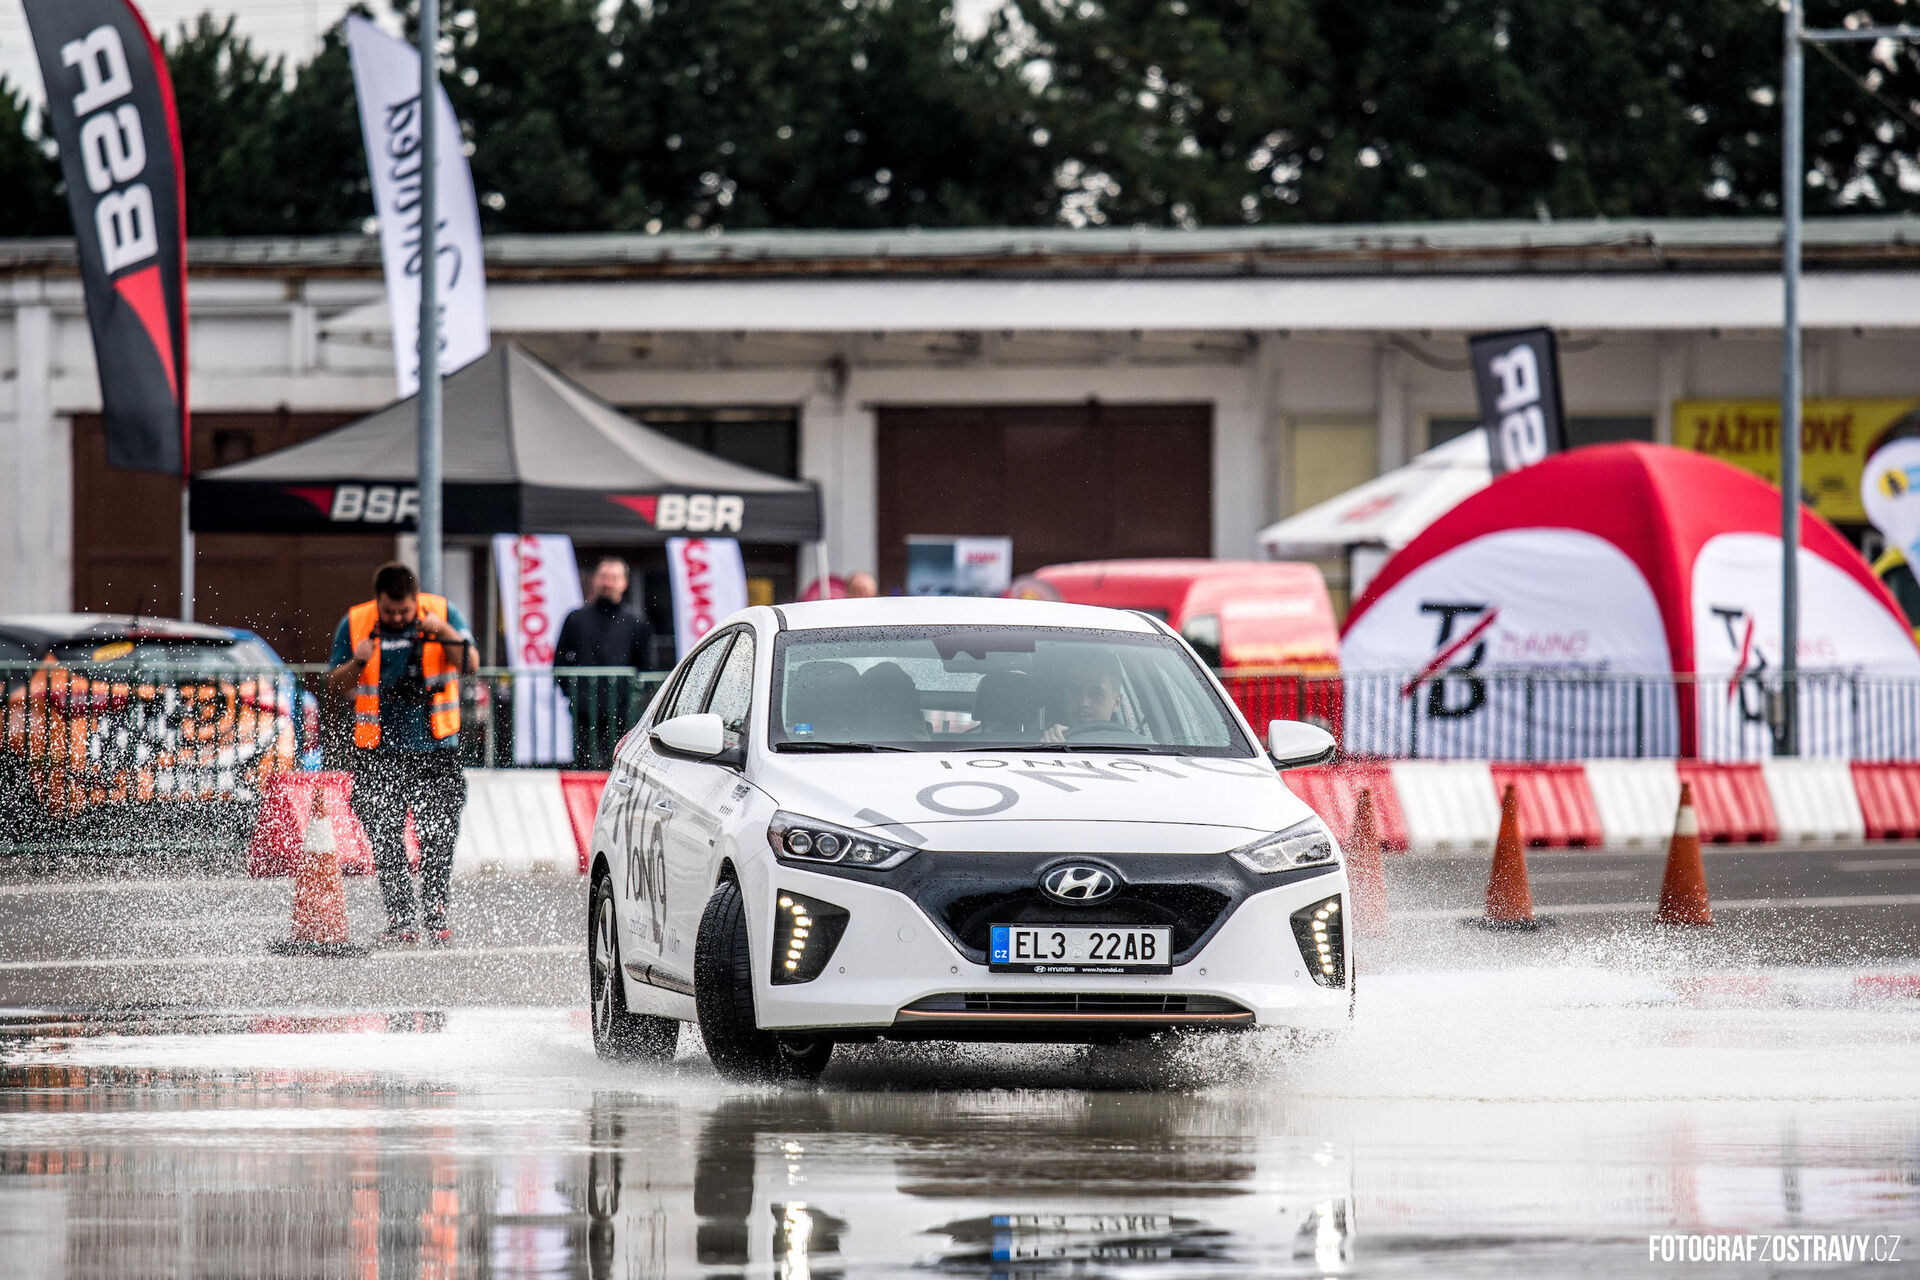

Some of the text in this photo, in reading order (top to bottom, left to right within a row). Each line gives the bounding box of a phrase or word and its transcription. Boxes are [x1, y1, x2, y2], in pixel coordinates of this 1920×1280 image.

[1693, 409, 1855, 454] ZÁŽITOVÉ
[656, 493, 745, 532] BSR
[941, 758, 1153, 773] IONIQ
[994, 950, 1008, 959] CZ
[1016, 931, 1157, 960] EL3 22AB
